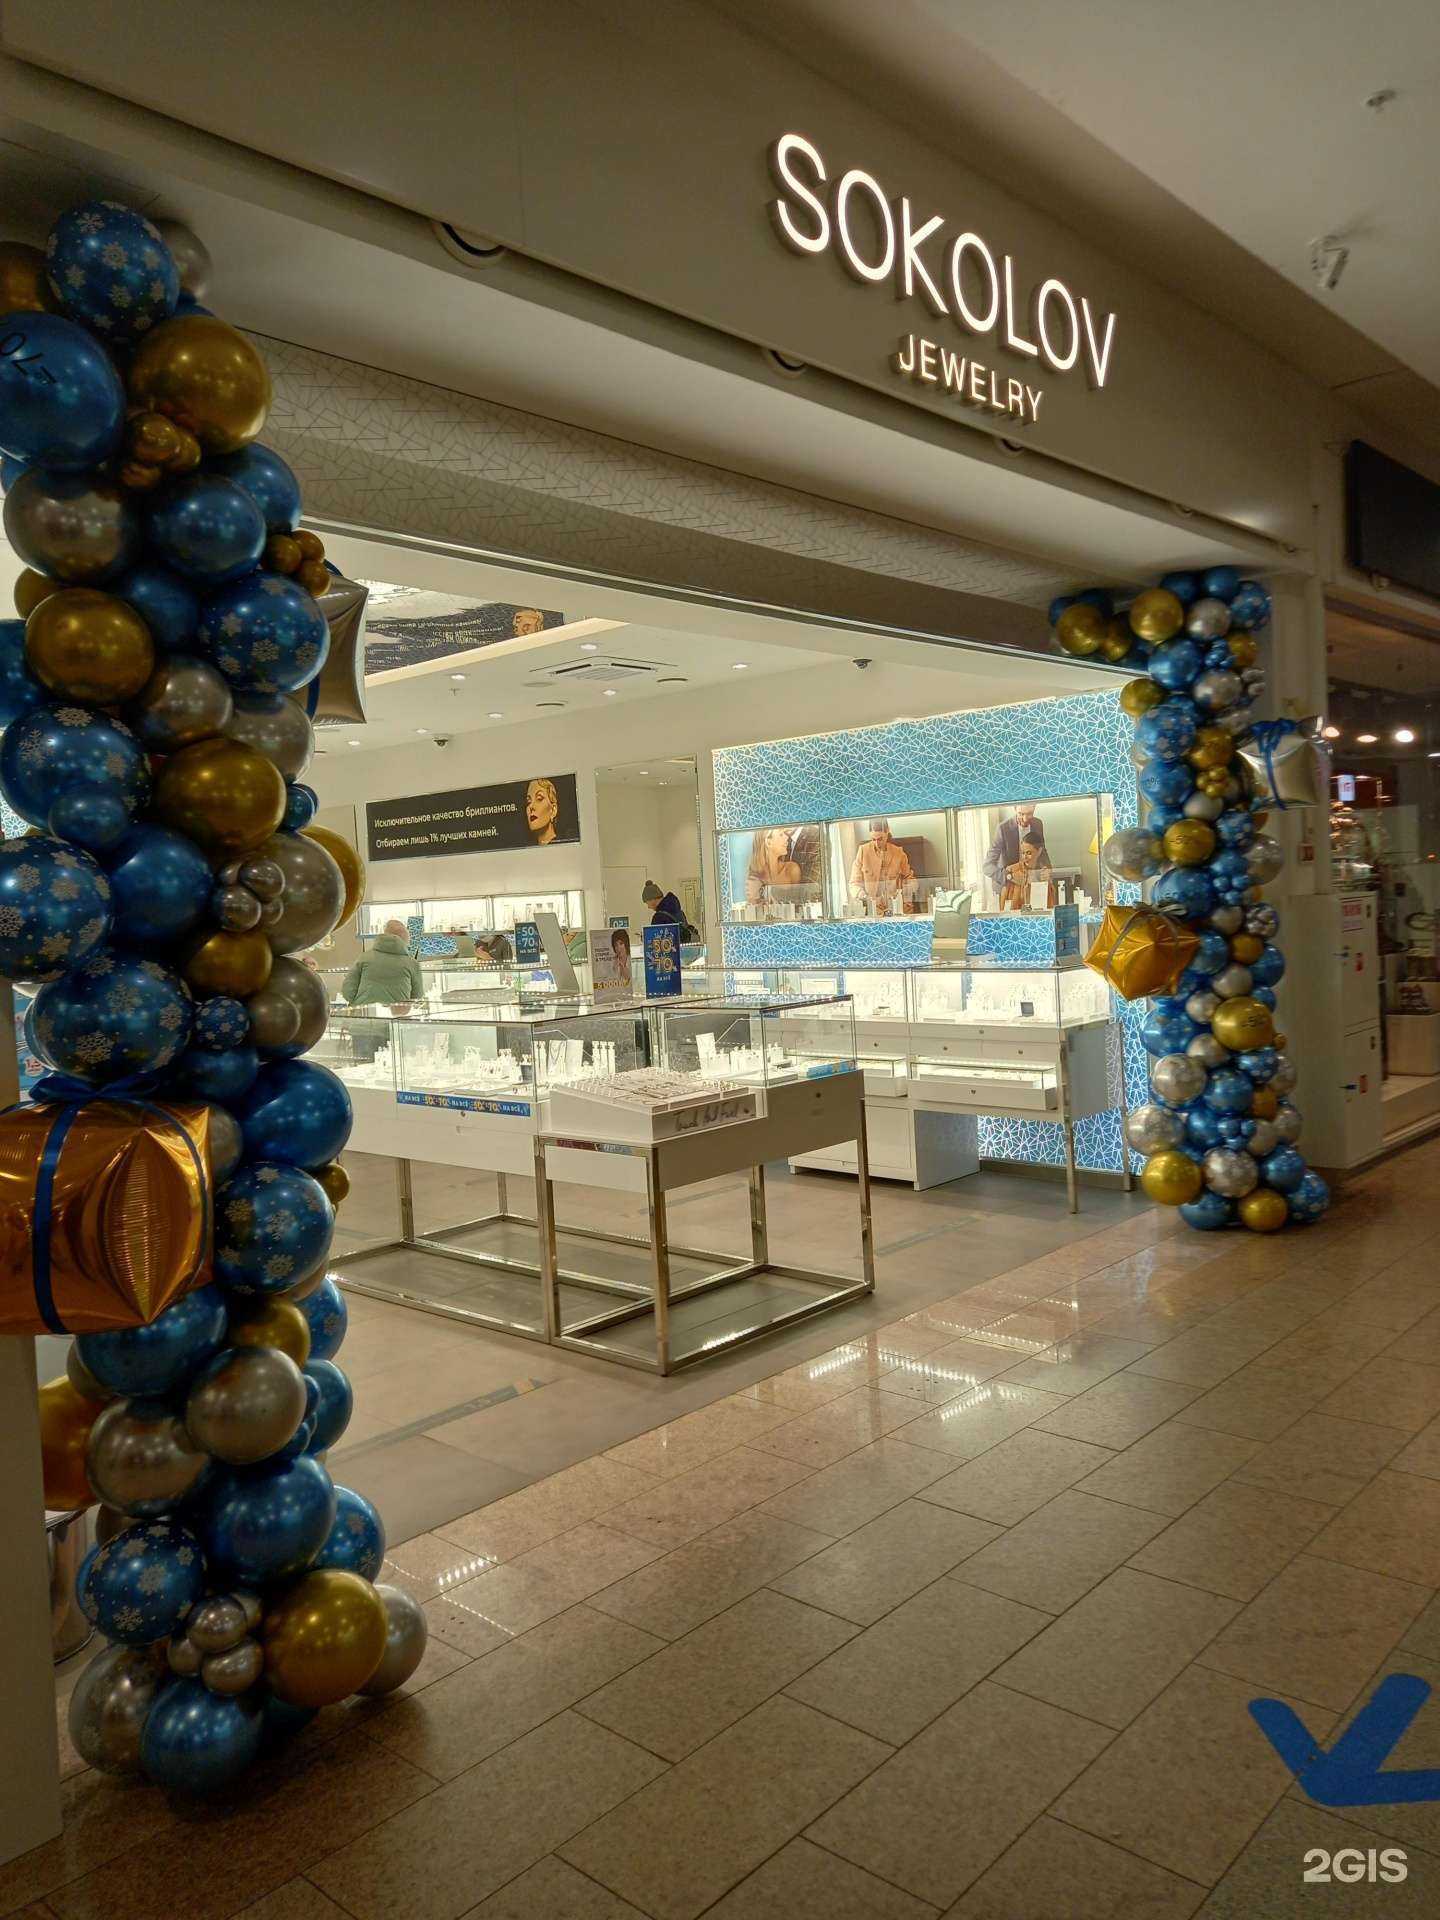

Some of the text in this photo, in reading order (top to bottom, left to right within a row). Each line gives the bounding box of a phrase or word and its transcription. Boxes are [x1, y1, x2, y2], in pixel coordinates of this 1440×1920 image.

[776, 133, 1118, 388] SOKOLOV
[896, 333, 1044, 423] JEWELRY
[374, 803, 518, 829] Исключительное качество бриллиантов.
[375, 826, 499, 850] Отбираем лишь 1% лучших камней.
